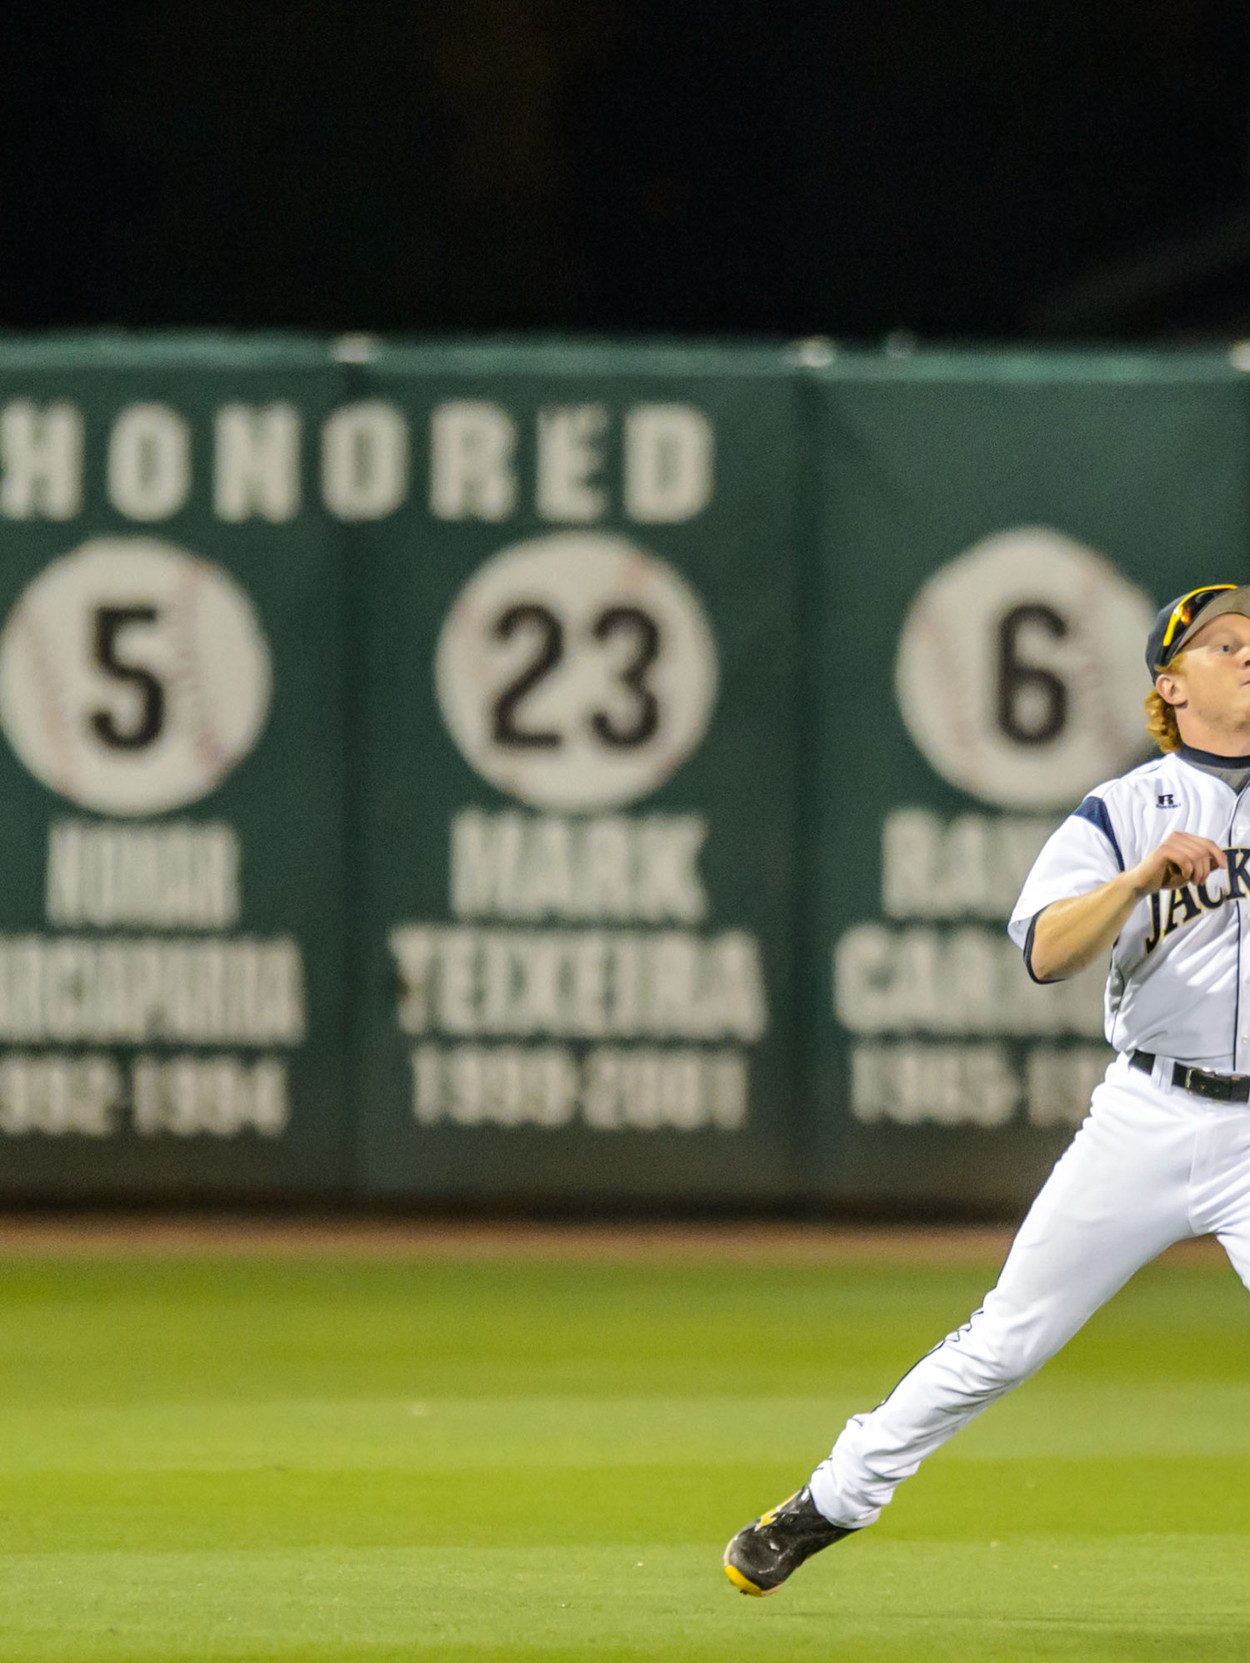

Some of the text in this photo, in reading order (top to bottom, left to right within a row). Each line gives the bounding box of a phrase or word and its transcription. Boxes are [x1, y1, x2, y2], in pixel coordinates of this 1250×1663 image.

[0, 400, 714, 522] HONORED
[89, 604, 167, 751] 5
[489, 602, 661, 748] 23
[995, 603, 1070, 746] 6
[449, 806, 709, 923] MARK
[391, 921, 768, 1043] TEIXEIRA
